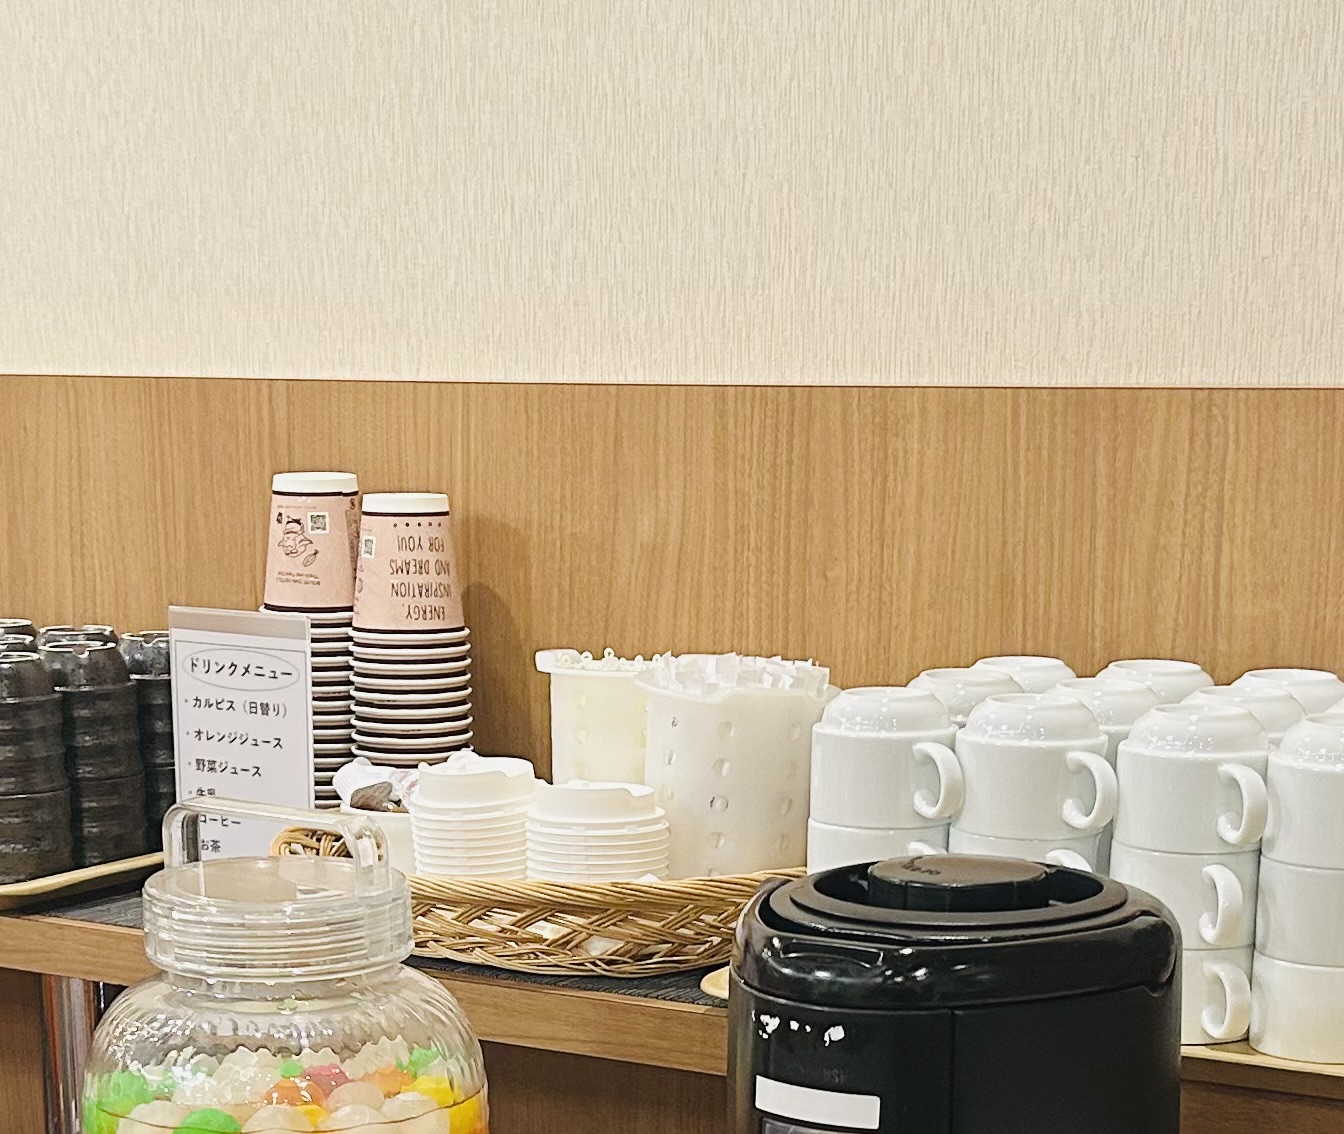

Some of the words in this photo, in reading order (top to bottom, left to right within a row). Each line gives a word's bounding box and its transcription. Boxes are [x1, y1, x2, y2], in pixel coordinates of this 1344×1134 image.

[428, 536, 445, 552] FOR
[389, 559, 430, 575] DREAMS
[434, 559, 451, 577] AND
[391, 582, 451, 598] INSPIRATION
[190, 657, 293, 680] ドリンクメニュー
